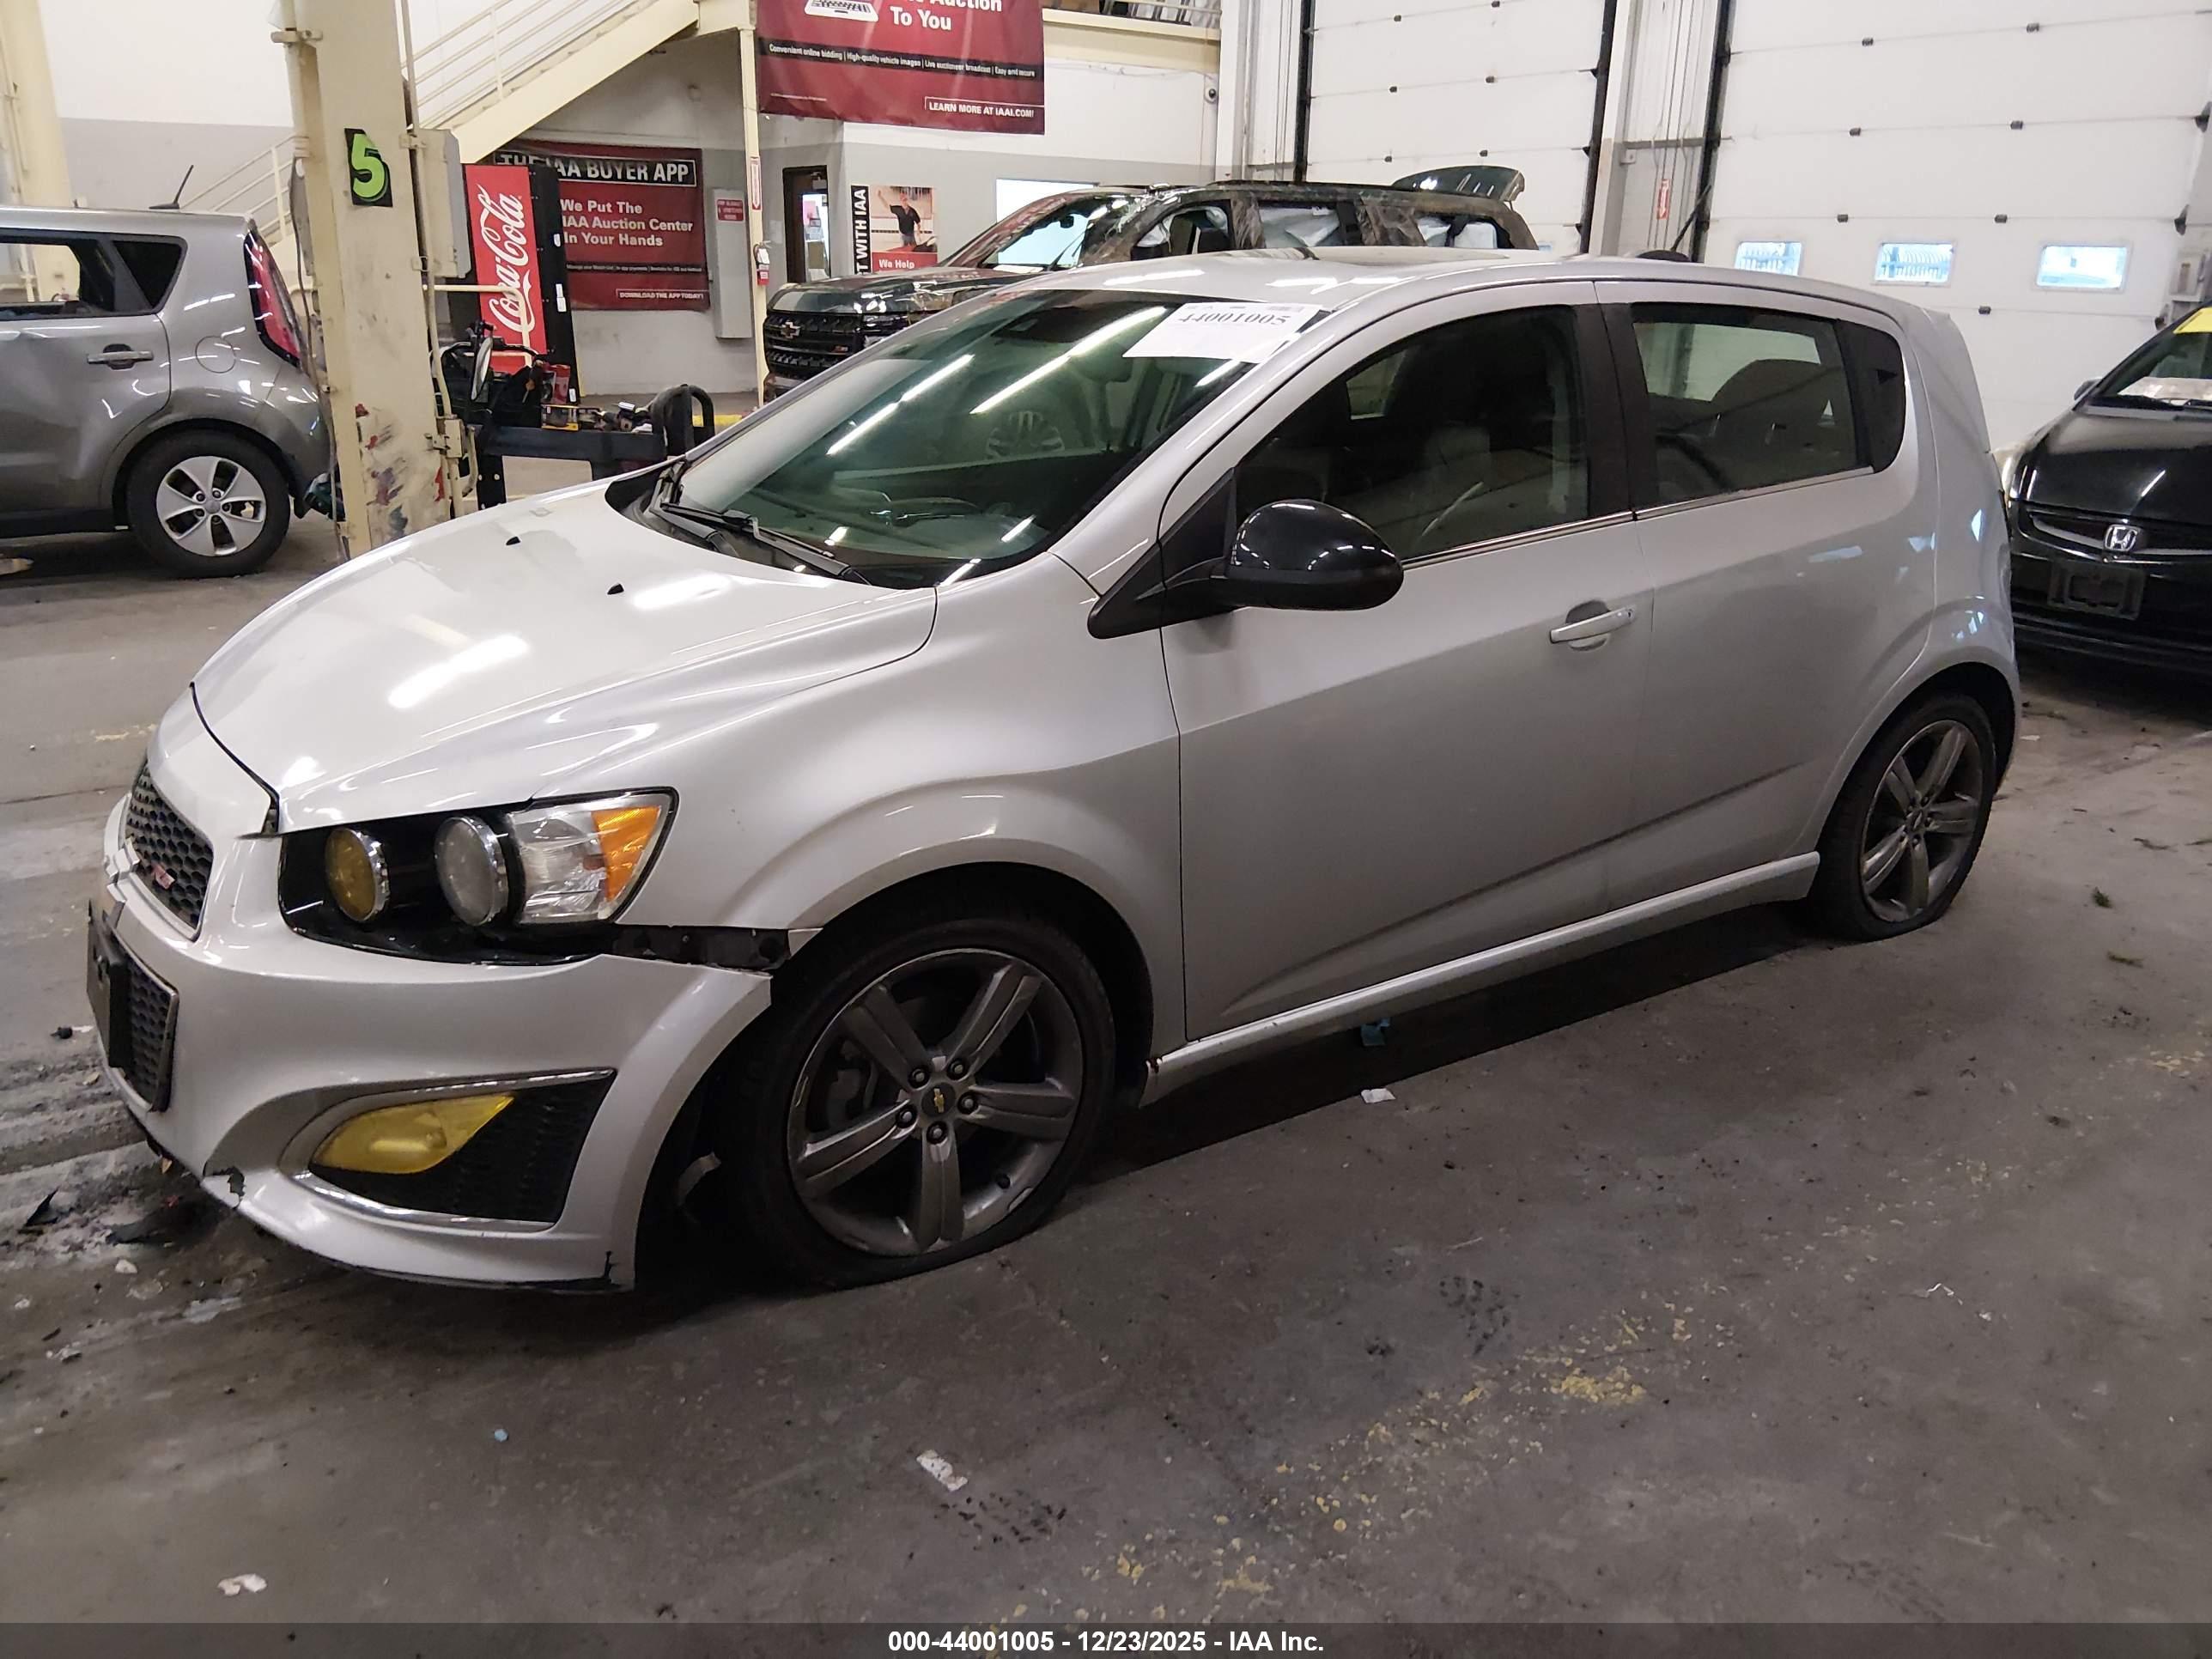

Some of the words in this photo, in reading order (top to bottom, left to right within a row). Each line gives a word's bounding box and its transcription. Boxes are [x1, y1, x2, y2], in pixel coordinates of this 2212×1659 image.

[930, 0, 1002, 11] uction
[890, 6, 913, 27] To
[917, 9, 951, 31] You
[769, 43, 803, 55] Convenient
[821, 50, 842, 60] bidding
[928, 101, 957, 112] LEARN
[958, 104, 982, 115] MORE
[983, 106, 994, 116] AT
[351, 133, 386, 199] 5
[586, 162, 649, 182] BUYER
[653, 163, 690, 184] APP
[560, 198, 583, 212] We
[587, 200, 612, 213] Put
[617, 201, 643, 214] The
[854, 189, 867, 216] IAA
[562, 216, 590, 228] IAA
[592, 216, 645, 230] Auction
[648, 218, 694, 232] Center
[563, 232, 577, 244] In
[581, 233, 615, 245] Your
[618, 233, 664, 246] Hands
[855, 219, 868, 259] WITH
[477, 184, 536, 333] Coca-Cola
[878, 259, 893, 269] We
[895, 259, 915, 270] Help
[1179, 312, 1291, 325] 44001005
